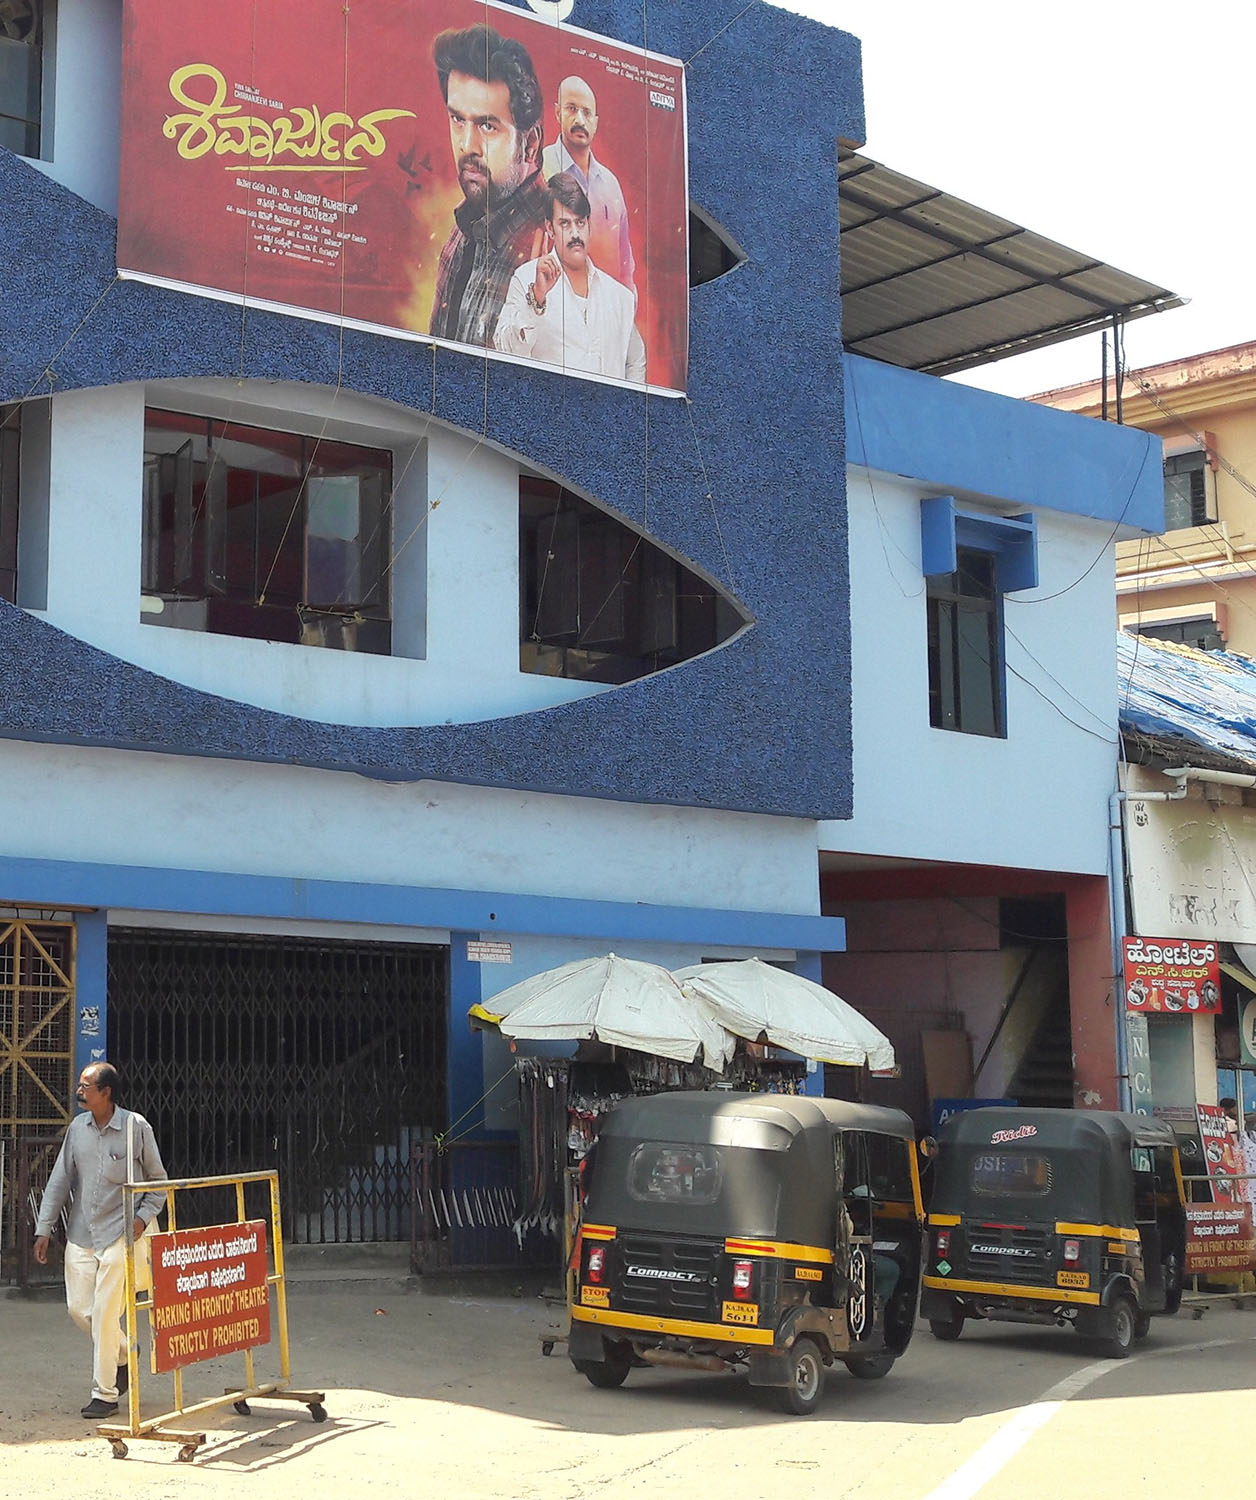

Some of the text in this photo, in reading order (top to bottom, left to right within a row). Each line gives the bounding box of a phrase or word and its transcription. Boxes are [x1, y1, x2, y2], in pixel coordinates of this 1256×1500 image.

[1126, 939, 1216, 966] ಹೋಟೆಲ್
[156, 1301, 191, 1330] PARKING
[192, 1298, 201, 1322] IN
[235, 1285, 267, 1311] THEATRE
[168, 1318, 260, 1358] STRICTLY PROHIBITED
